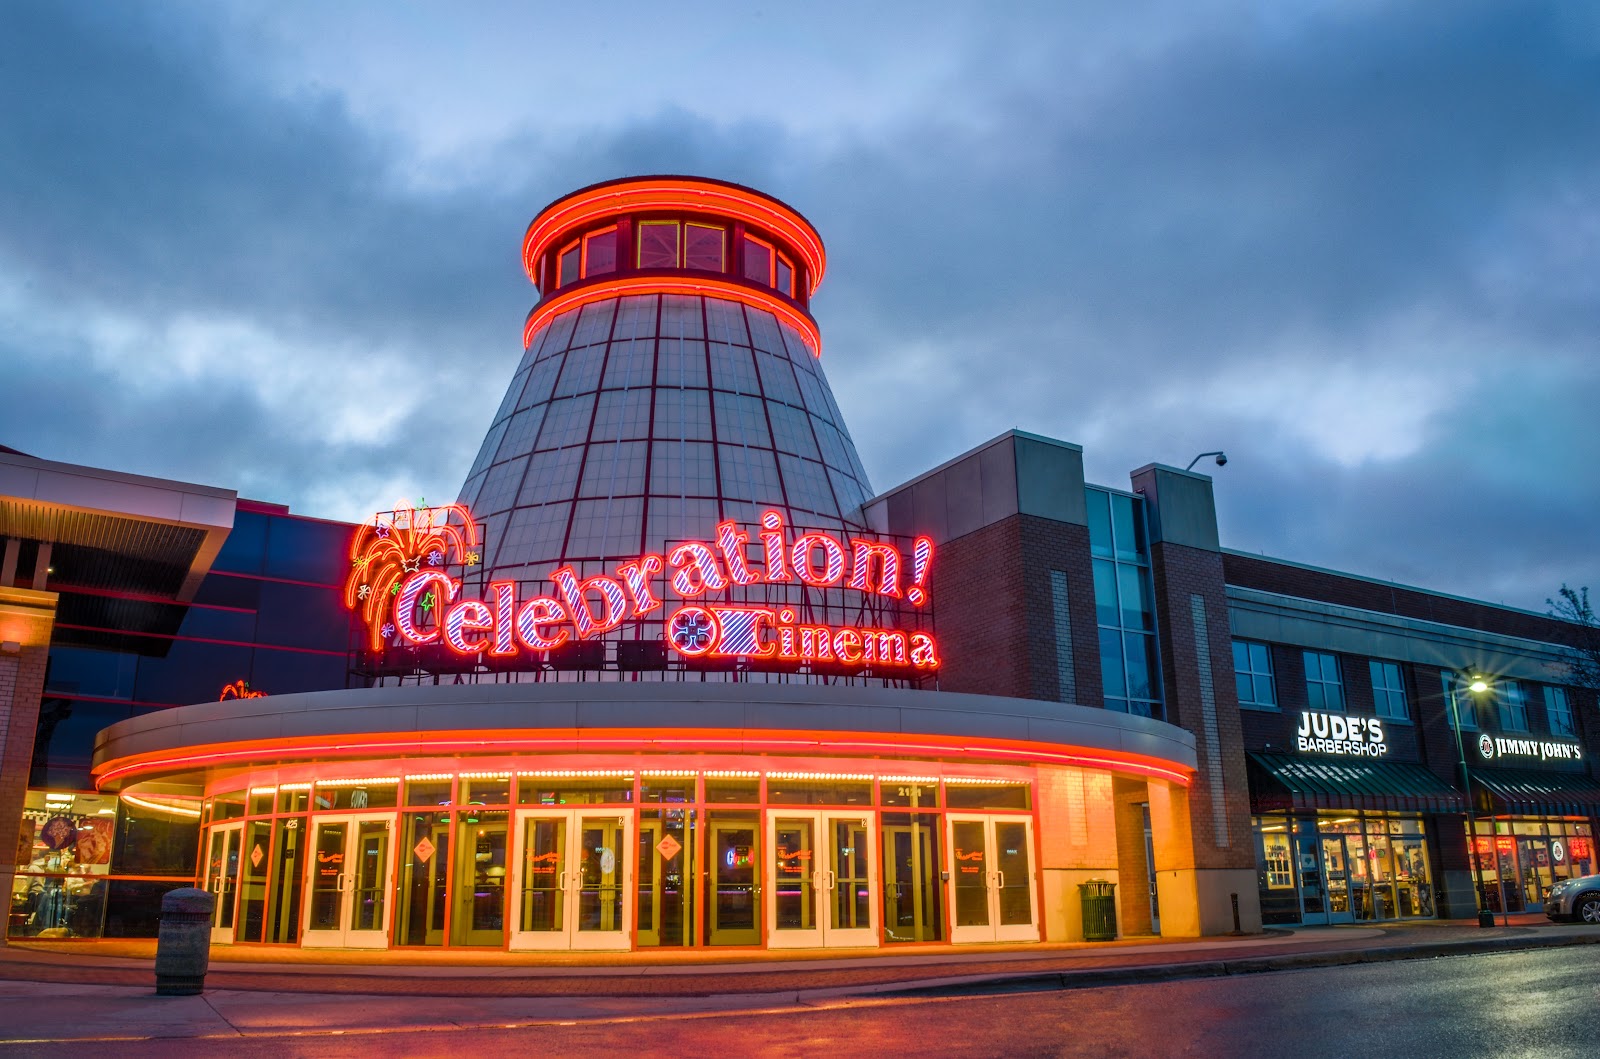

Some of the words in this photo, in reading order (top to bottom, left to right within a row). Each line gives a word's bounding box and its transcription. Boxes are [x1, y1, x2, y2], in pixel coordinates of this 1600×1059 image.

[392, 510, 937, 657] Celebration!
[700, 606, 942, 670] Cinema
[1298, 711, 1384, 743] JUDE'S
[1297, 736, 1387, 757] BARBERSHOP
[1495, 738, 1538, 758] JIMMY
[1539, 742, 1581, 761] JOHN'S
